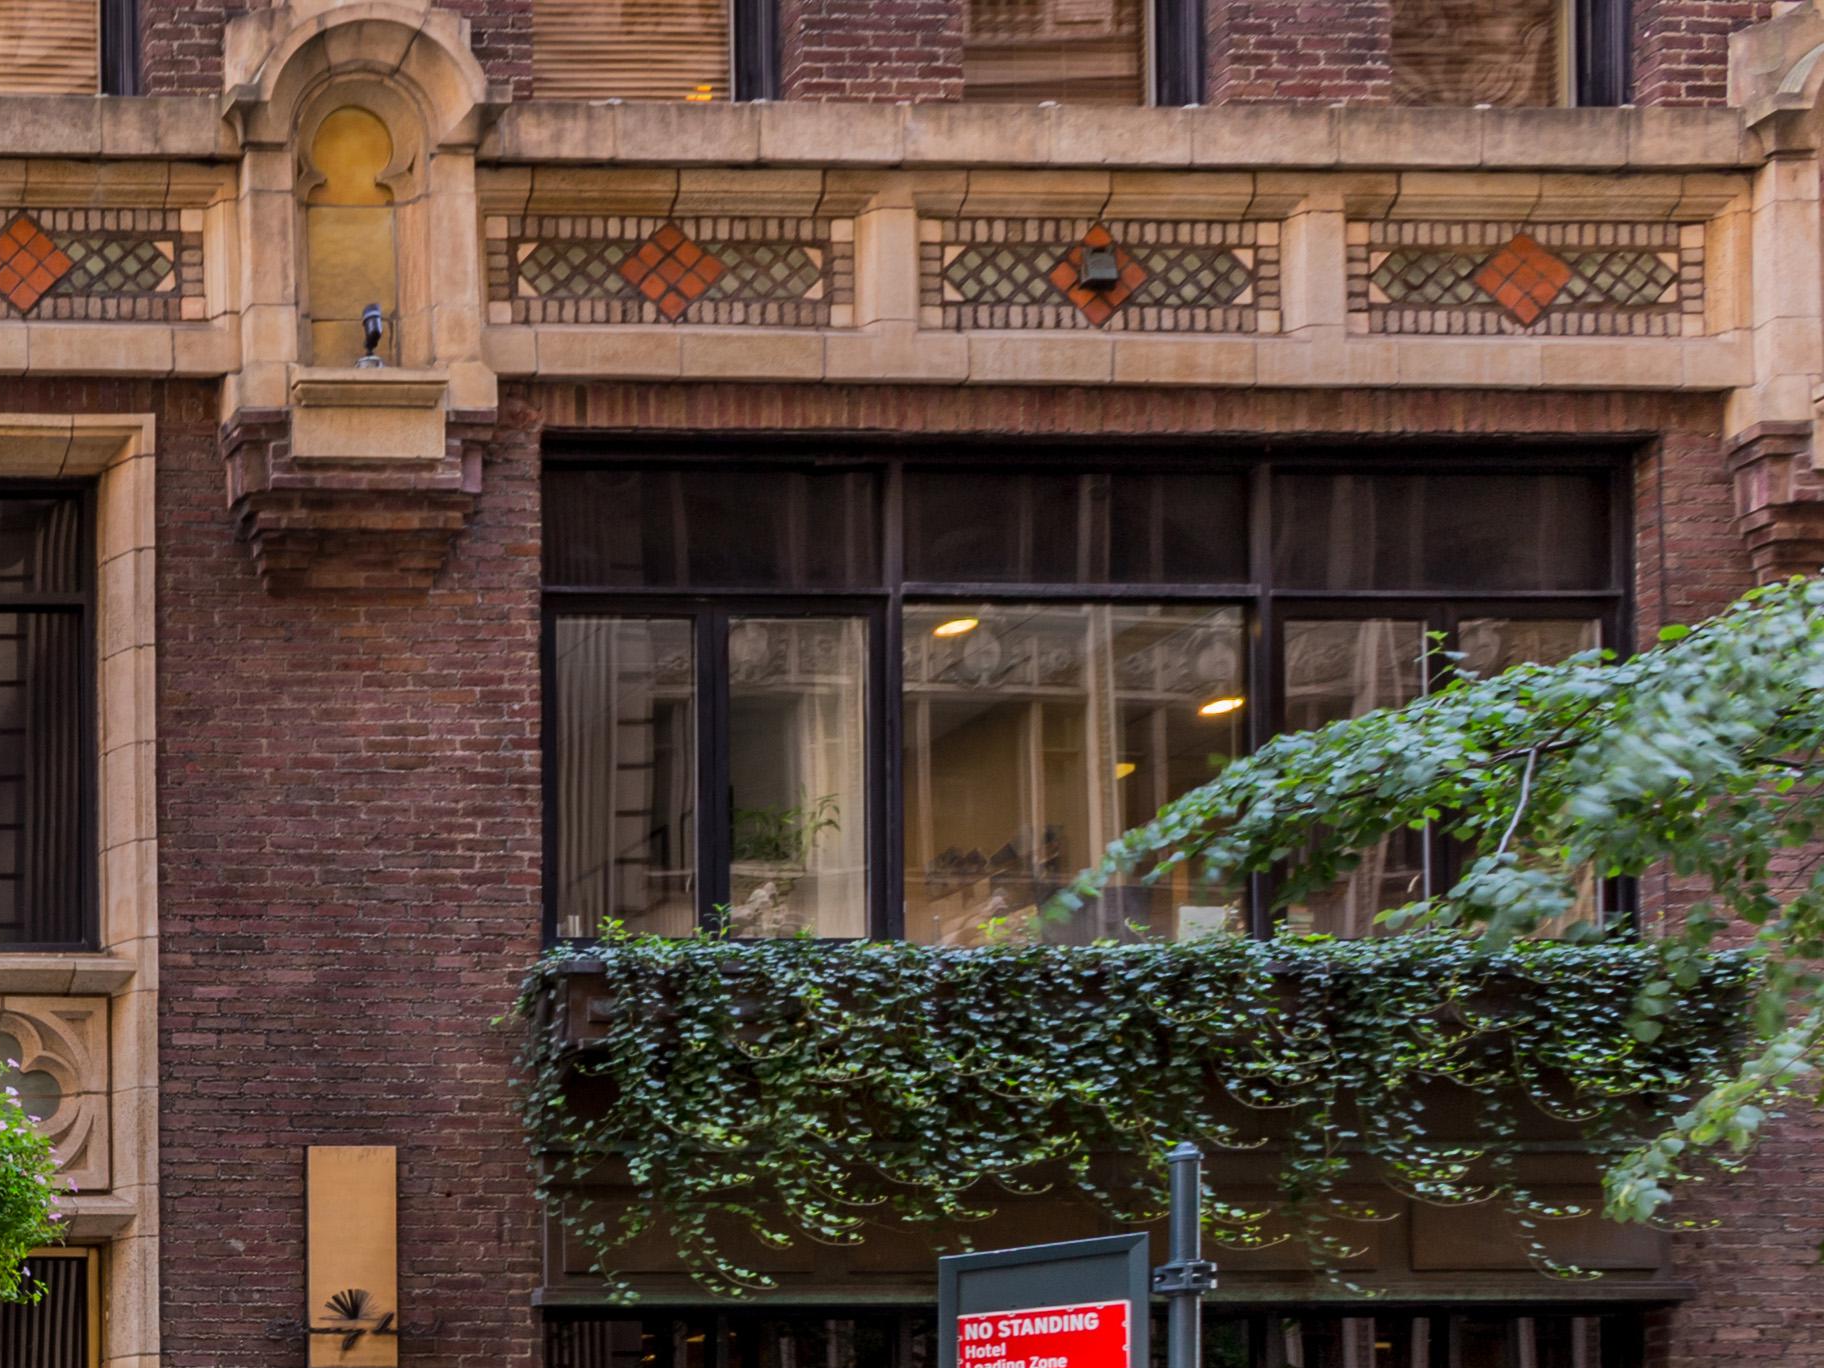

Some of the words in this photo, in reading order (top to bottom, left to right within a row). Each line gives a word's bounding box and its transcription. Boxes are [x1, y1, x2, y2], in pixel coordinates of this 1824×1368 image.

[964, 1322, 994, 1341] NO
[997, 1312, 1100, 1338] STANDING
[965, 1342, 1007, 1360] Hotel
